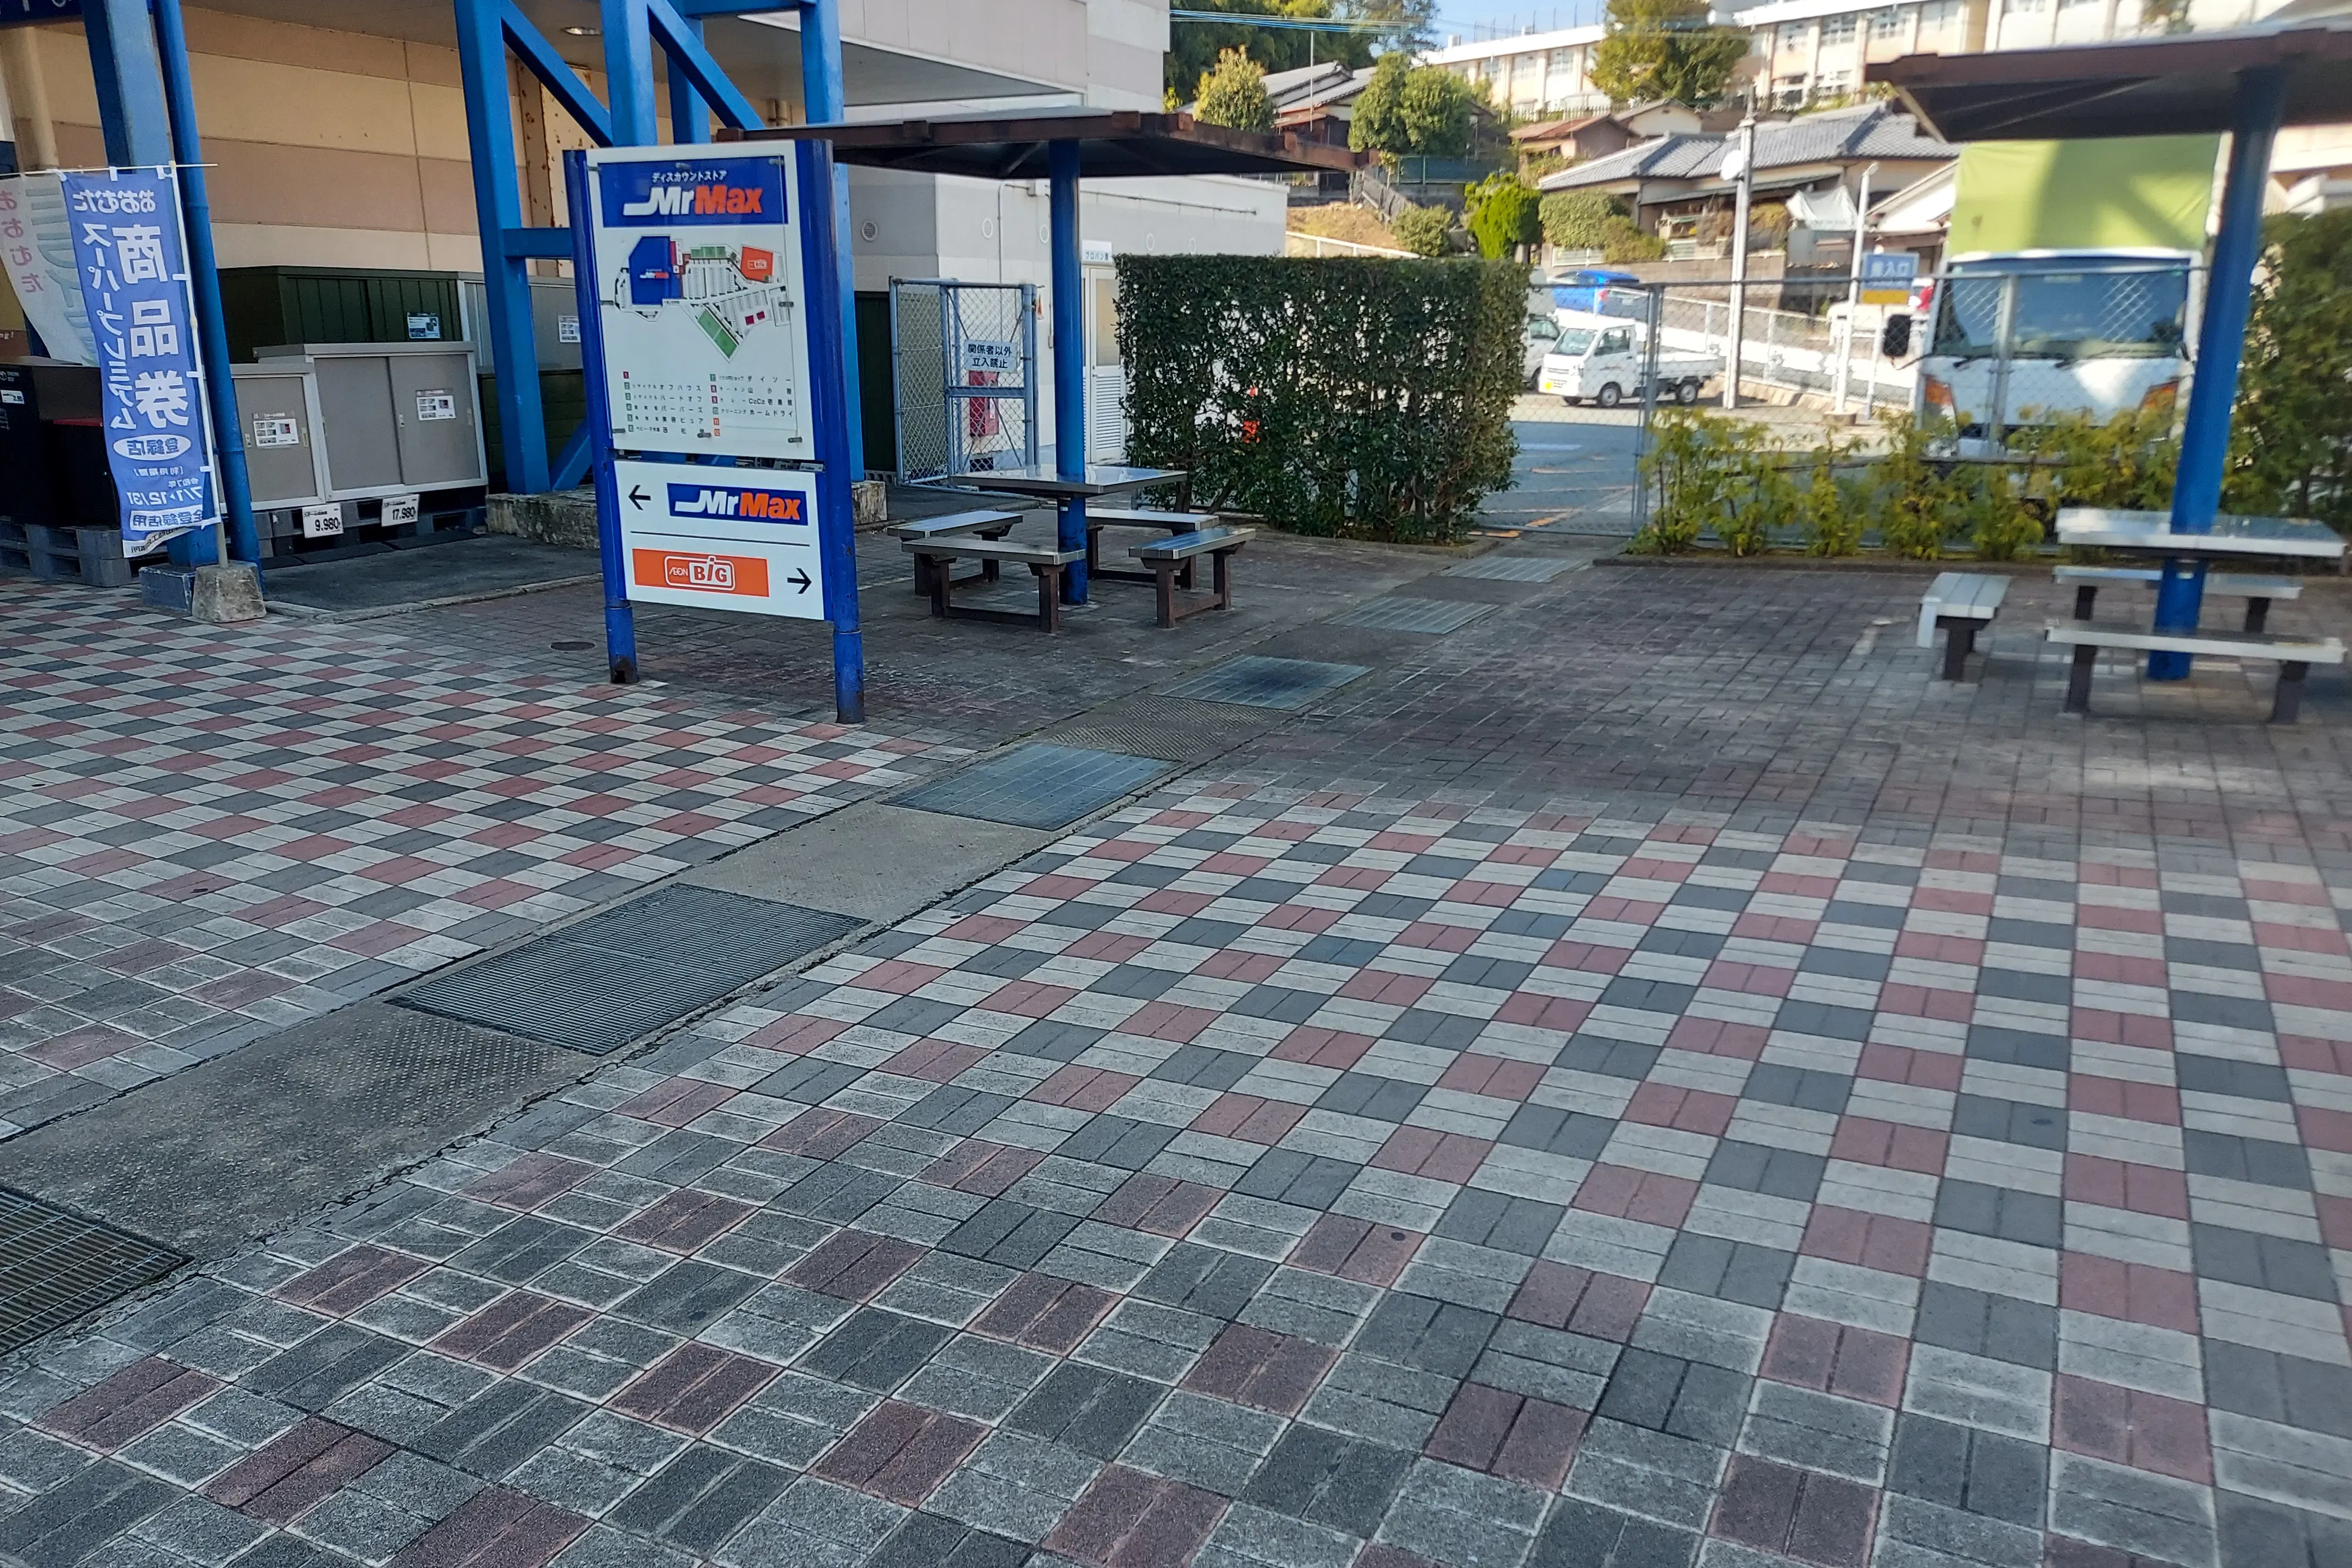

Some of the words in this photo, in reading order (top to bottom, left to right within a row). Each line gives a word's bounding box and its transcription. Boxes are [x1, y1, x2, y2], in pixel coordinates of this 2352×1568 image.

[652, 170, 727, 183] ディスカウントストア
[623, 184, 763, 216] MrMax
[968, 344, 1012, 356] 関係者以外
[972, 357, 1008, 369] 立入禁止
[674, 490, 801, 520] MrMax
